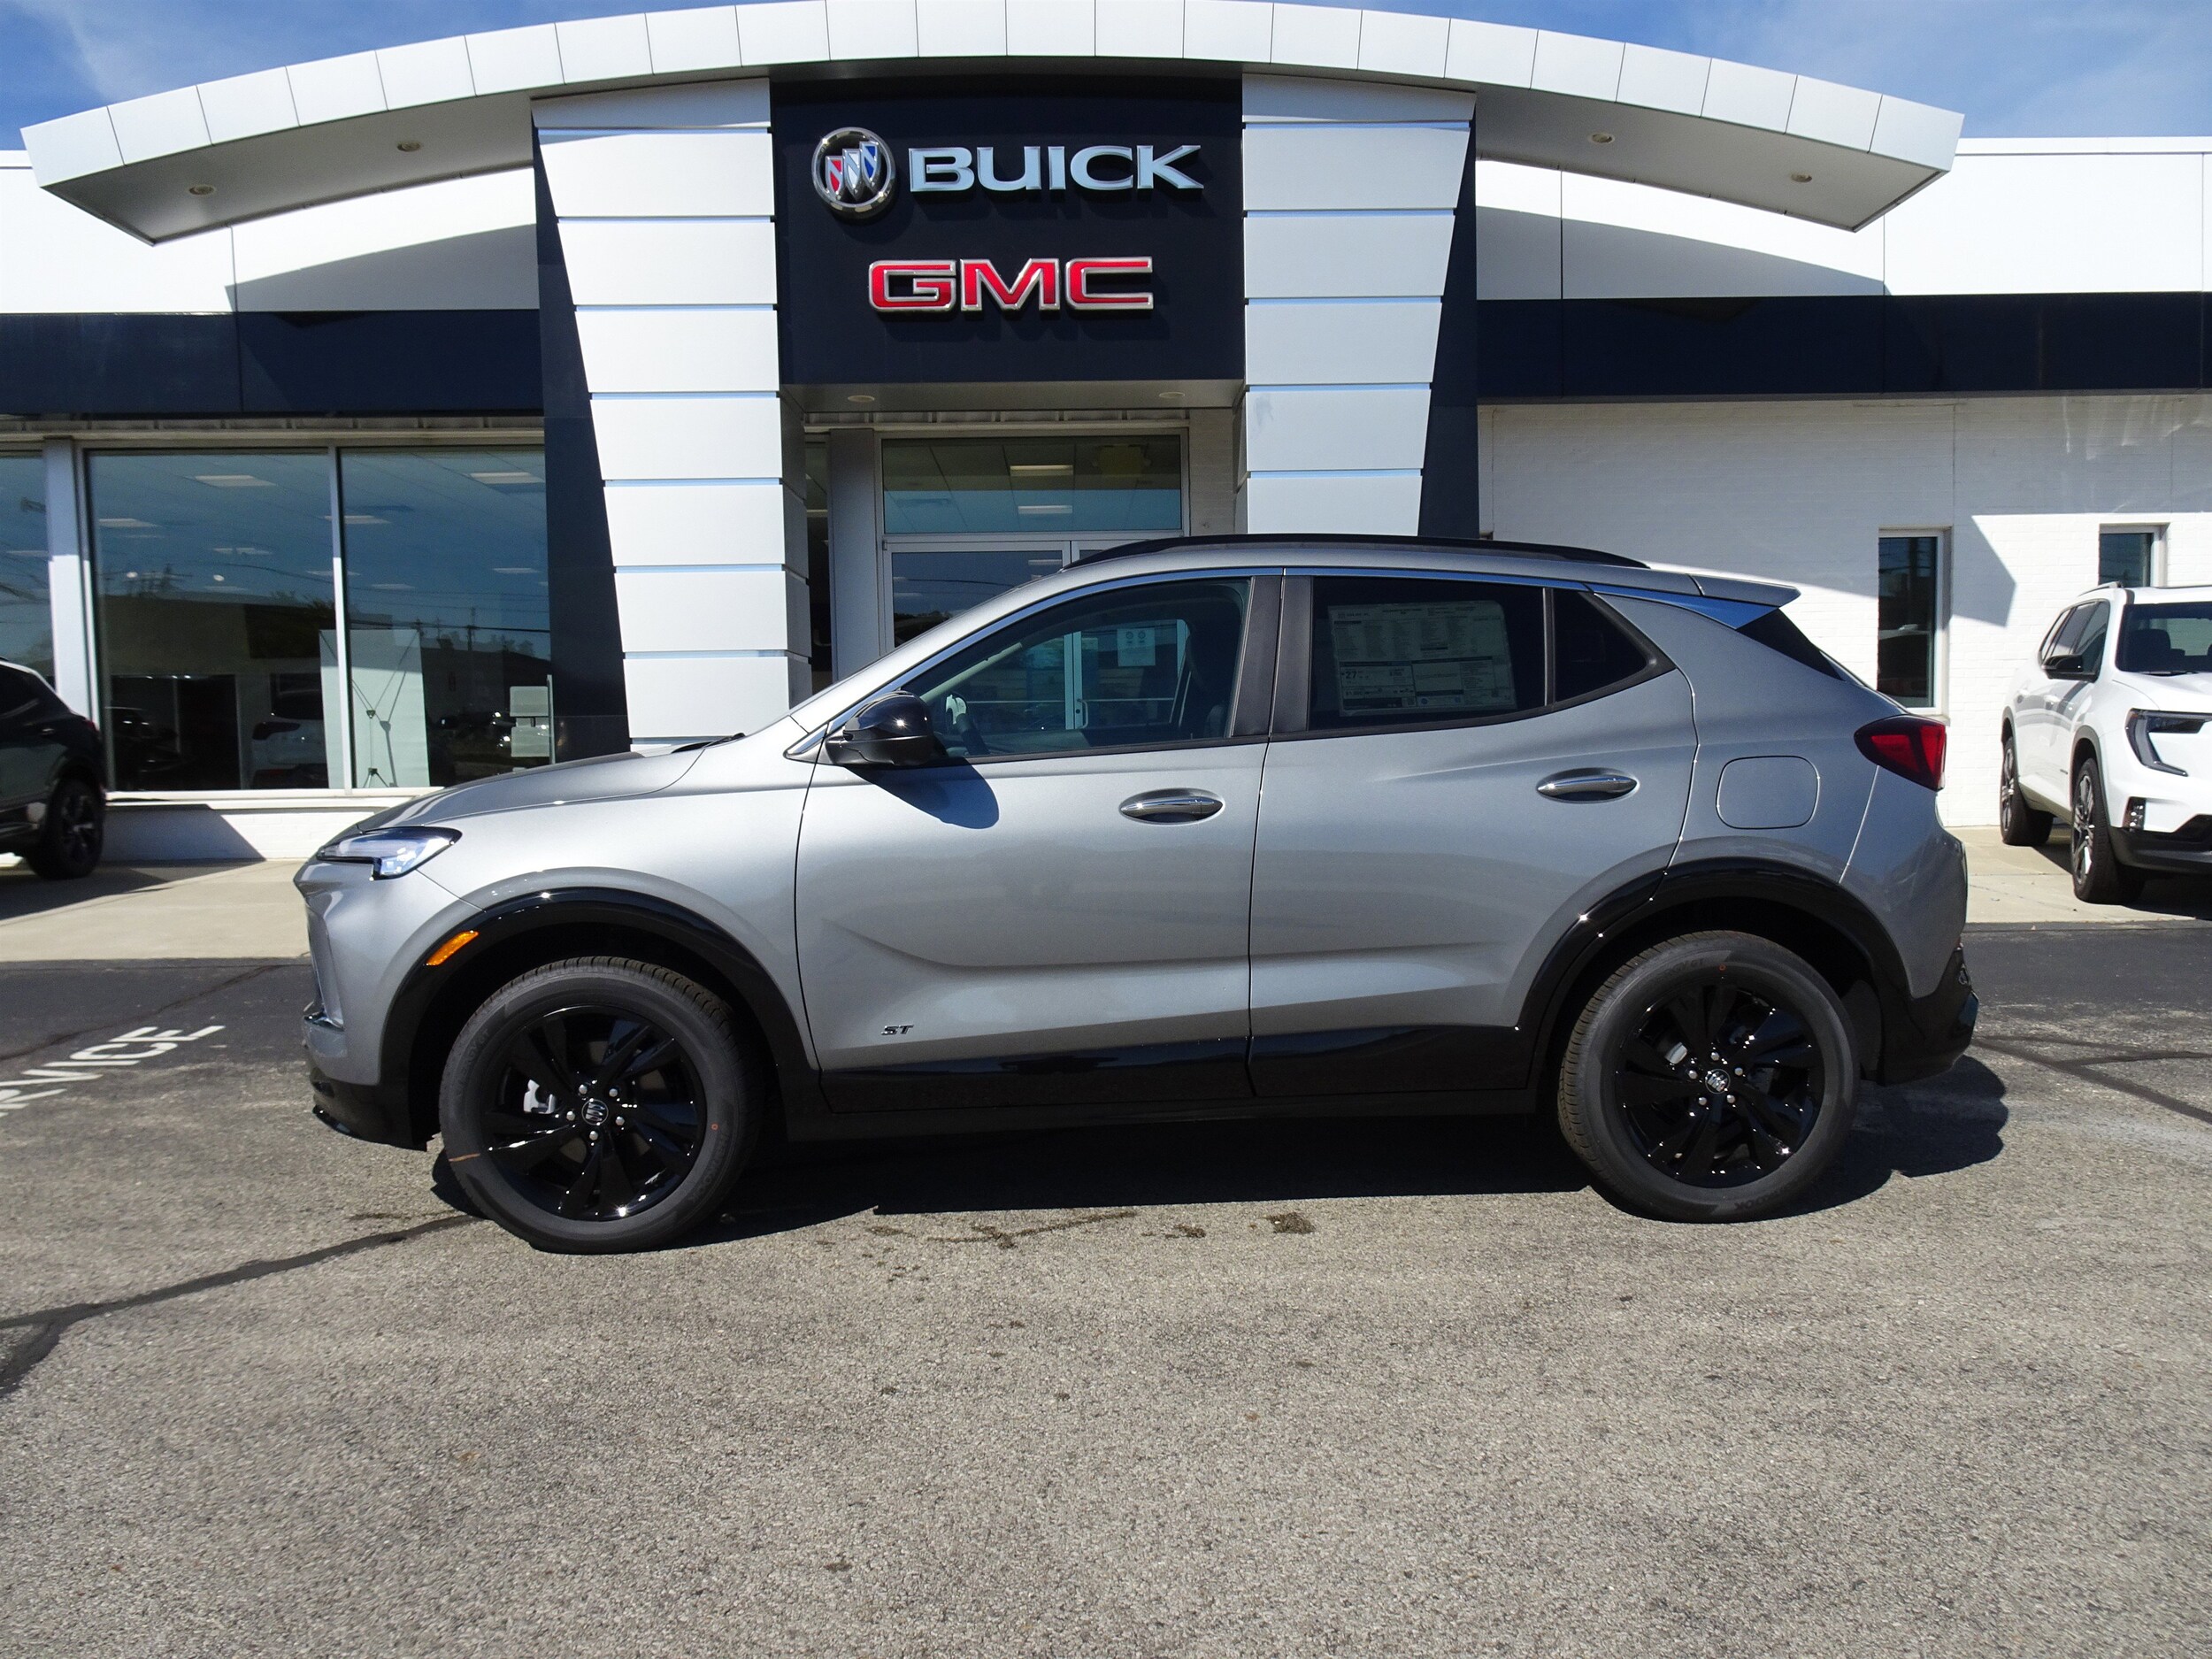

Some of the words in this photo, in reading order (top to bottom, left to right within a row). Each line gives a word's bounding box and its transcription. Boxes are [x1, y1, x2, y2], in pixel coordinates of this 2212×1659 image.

[908, 145, 1204, 192] BUICK
[868, 256, 1155, 312] GMC
[880, 1024, 915, 1036] ST
[0, 1025, 227, 1116] RVICE
